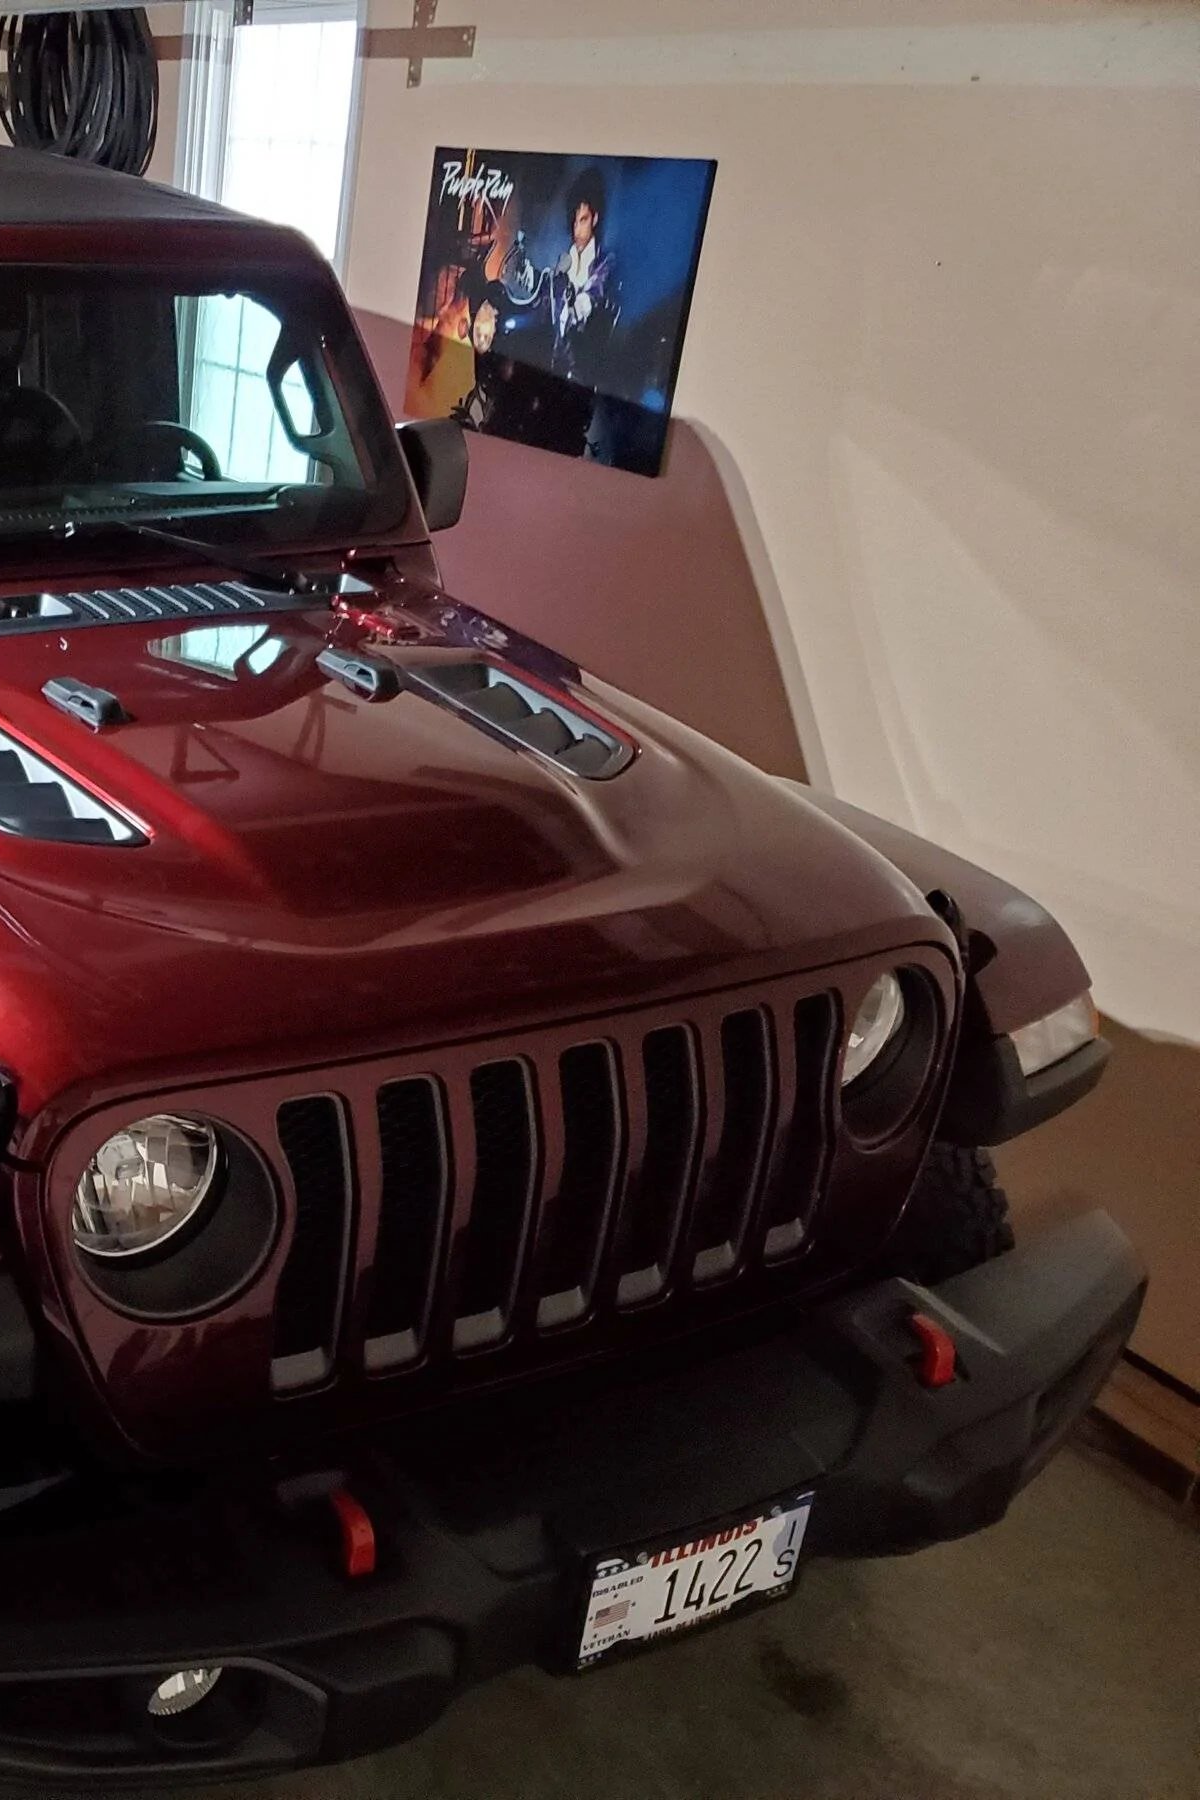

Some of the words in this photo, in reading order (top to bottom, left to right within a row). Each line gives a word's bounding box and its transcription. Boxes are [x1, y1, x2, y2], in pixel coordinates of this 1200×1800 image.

[438, 161, 485, 210] Purple
[479, 168, 514, 225] Rain
[650, 1519, 759, 1569] ILLINOIS
[592, 1575, 644, 1599] DISABLED
[653, 1538, 763, 1625] 1422
[582, 1628, 631, 1652] VETERAN
